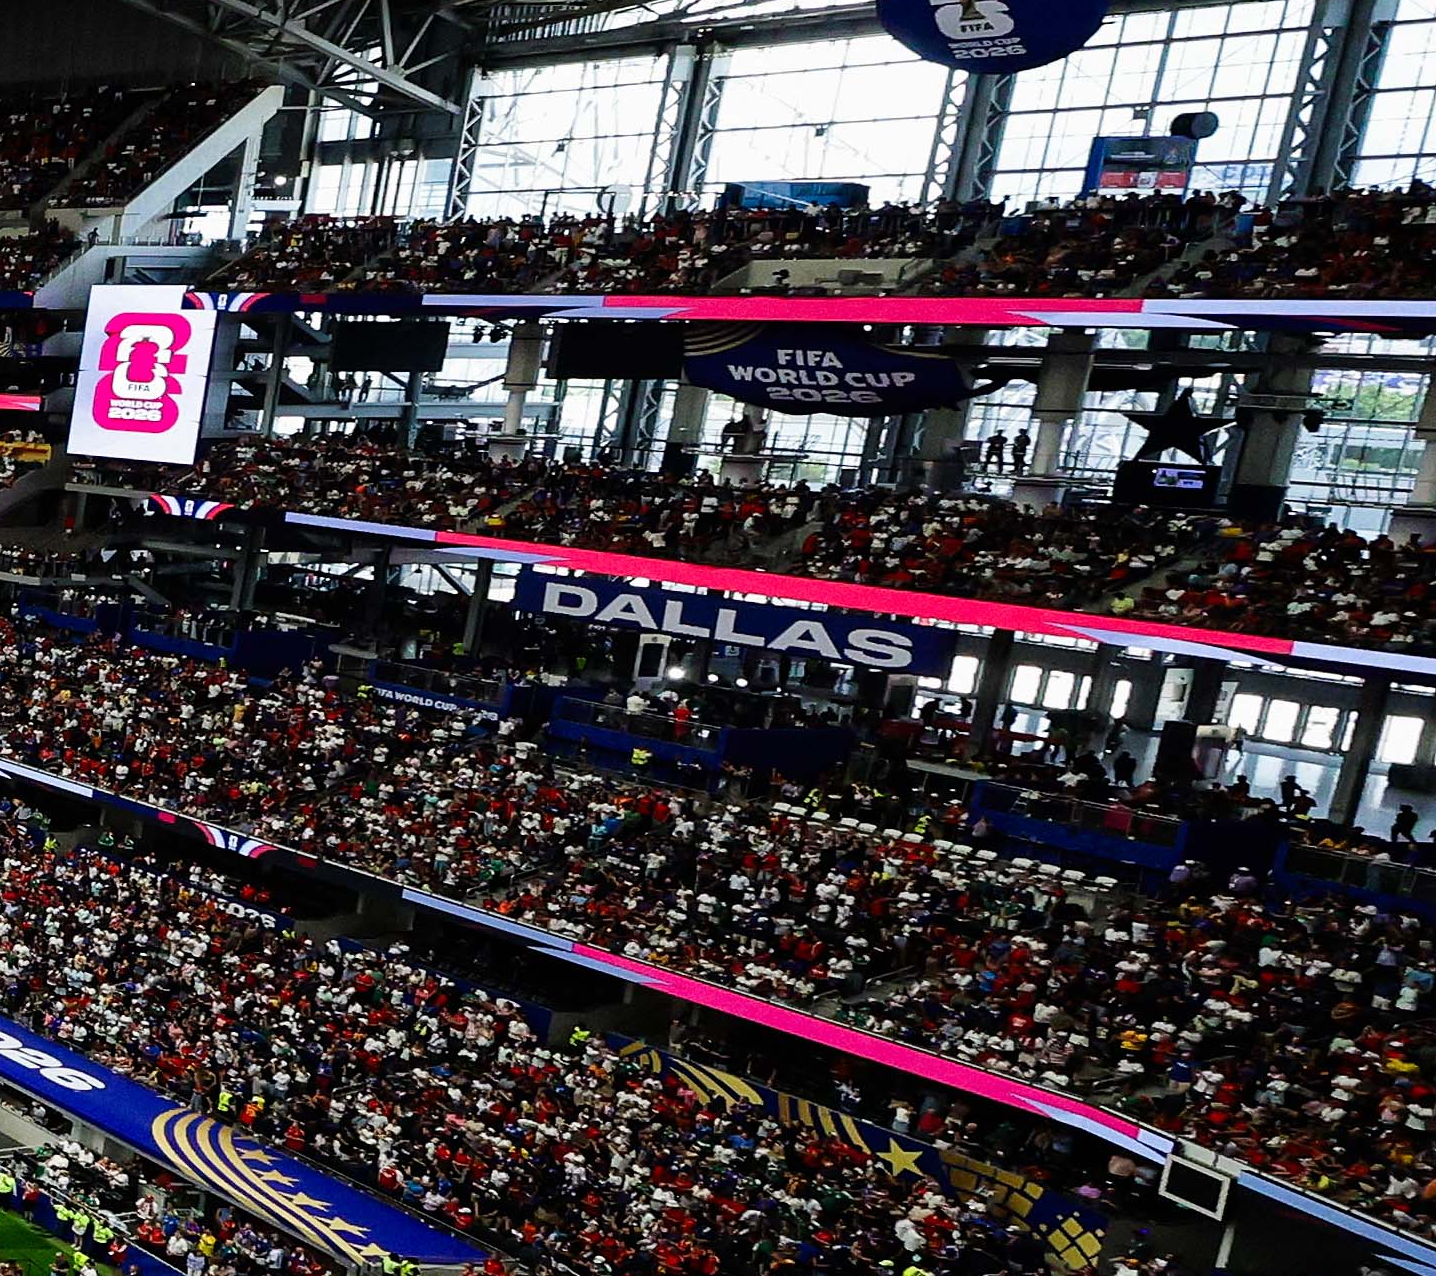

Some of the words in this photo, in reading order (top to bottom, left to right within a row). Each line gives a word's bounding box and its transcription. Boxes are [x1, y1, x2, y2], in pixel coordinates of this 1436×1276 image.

[960, 21, 994, 33] FIFA
[953, 45, 1027, 59] 2026
[776, 349, 844, 369] FIFA
[727, 364, 839, 386] WORLD
[844, 372, 915, 388] CUP
[128, 383, 151, 392] FIFA
[766, 386, 884, 403] 2026
[542, 581, 914, 669] DALLAS
[395, 692, 434, 707] WORLD
